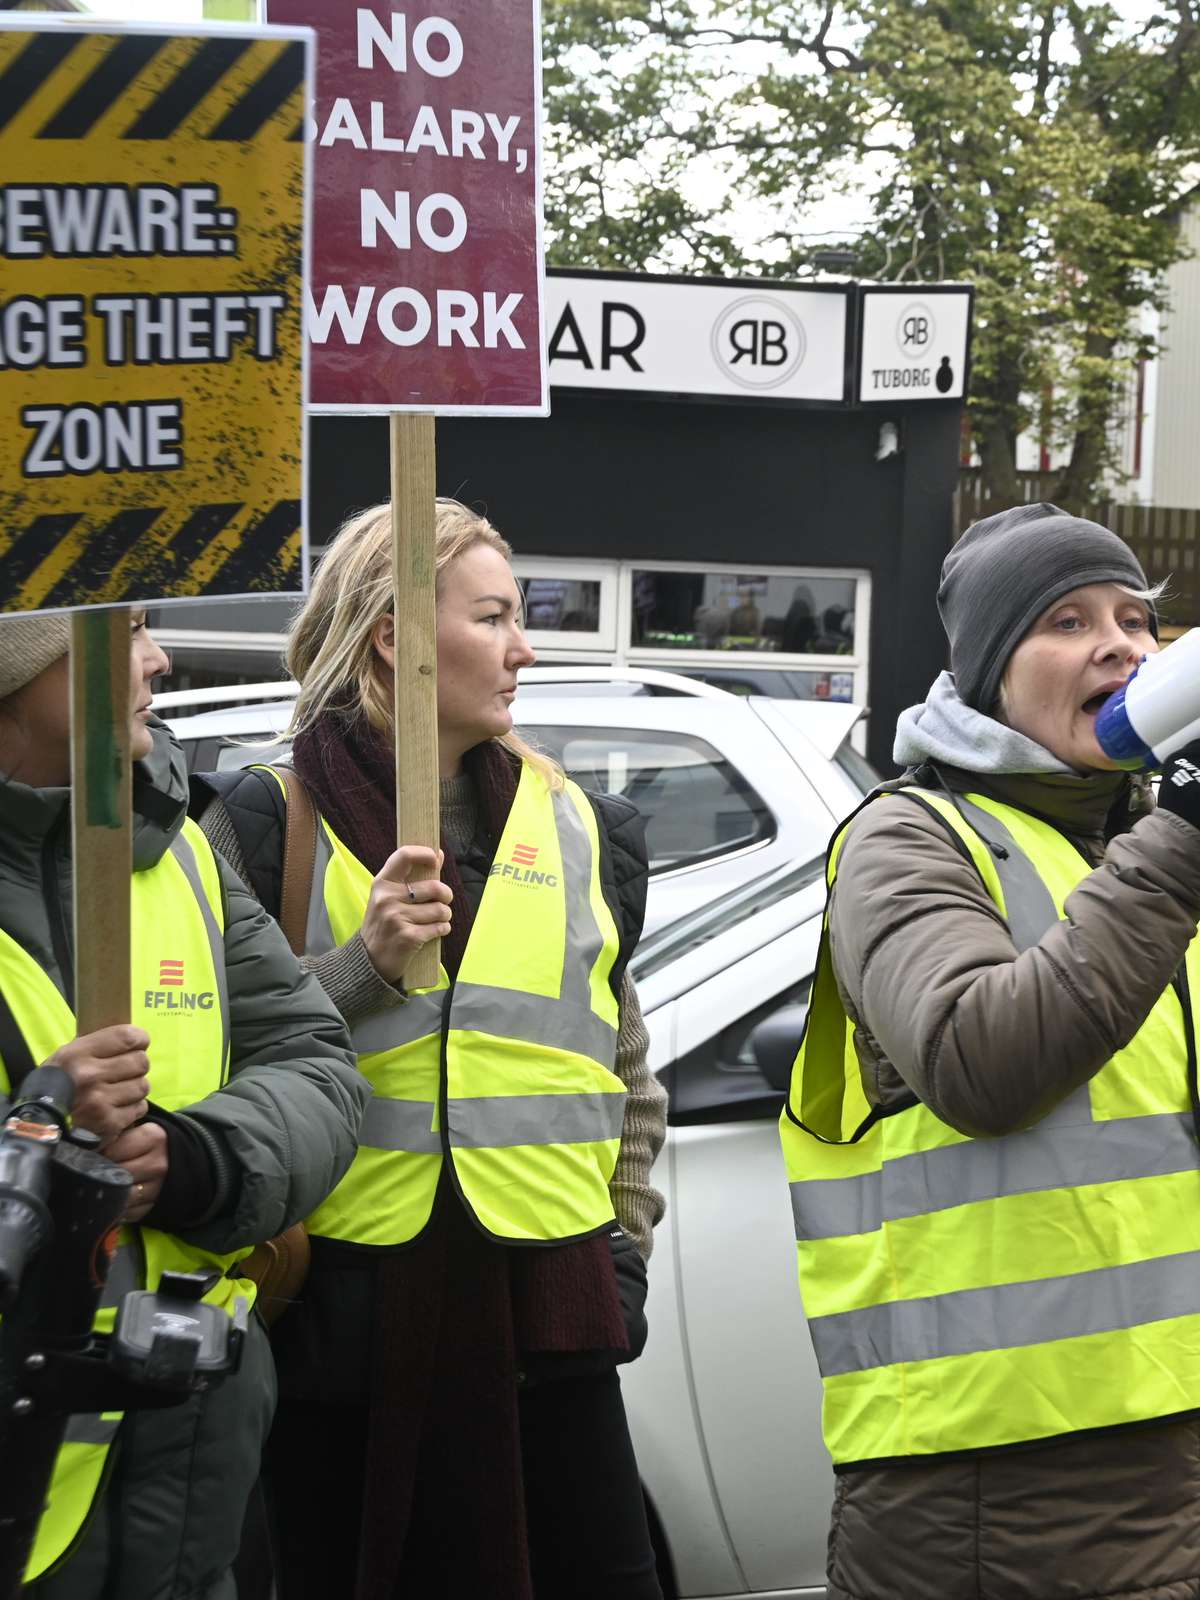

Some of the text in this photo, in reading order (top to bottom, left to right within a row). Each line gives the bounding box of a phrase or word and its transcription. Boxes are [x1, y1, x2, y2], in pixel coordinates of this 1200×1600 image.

[356, 8, 464, 78] NO
[312, 97, 528, 174] ALARY,
[0, 186, 237, 255] EWARE:
[360, 188, 468, 253] NO
[0, 295, 285, 366] GE THEFT
[308, 284, 526, 350] WORK
[872, 368, 931, 389] TUBORG
[23, 404, 180, 473] ZONE
[144, 990, 215, 1010] EFLING
